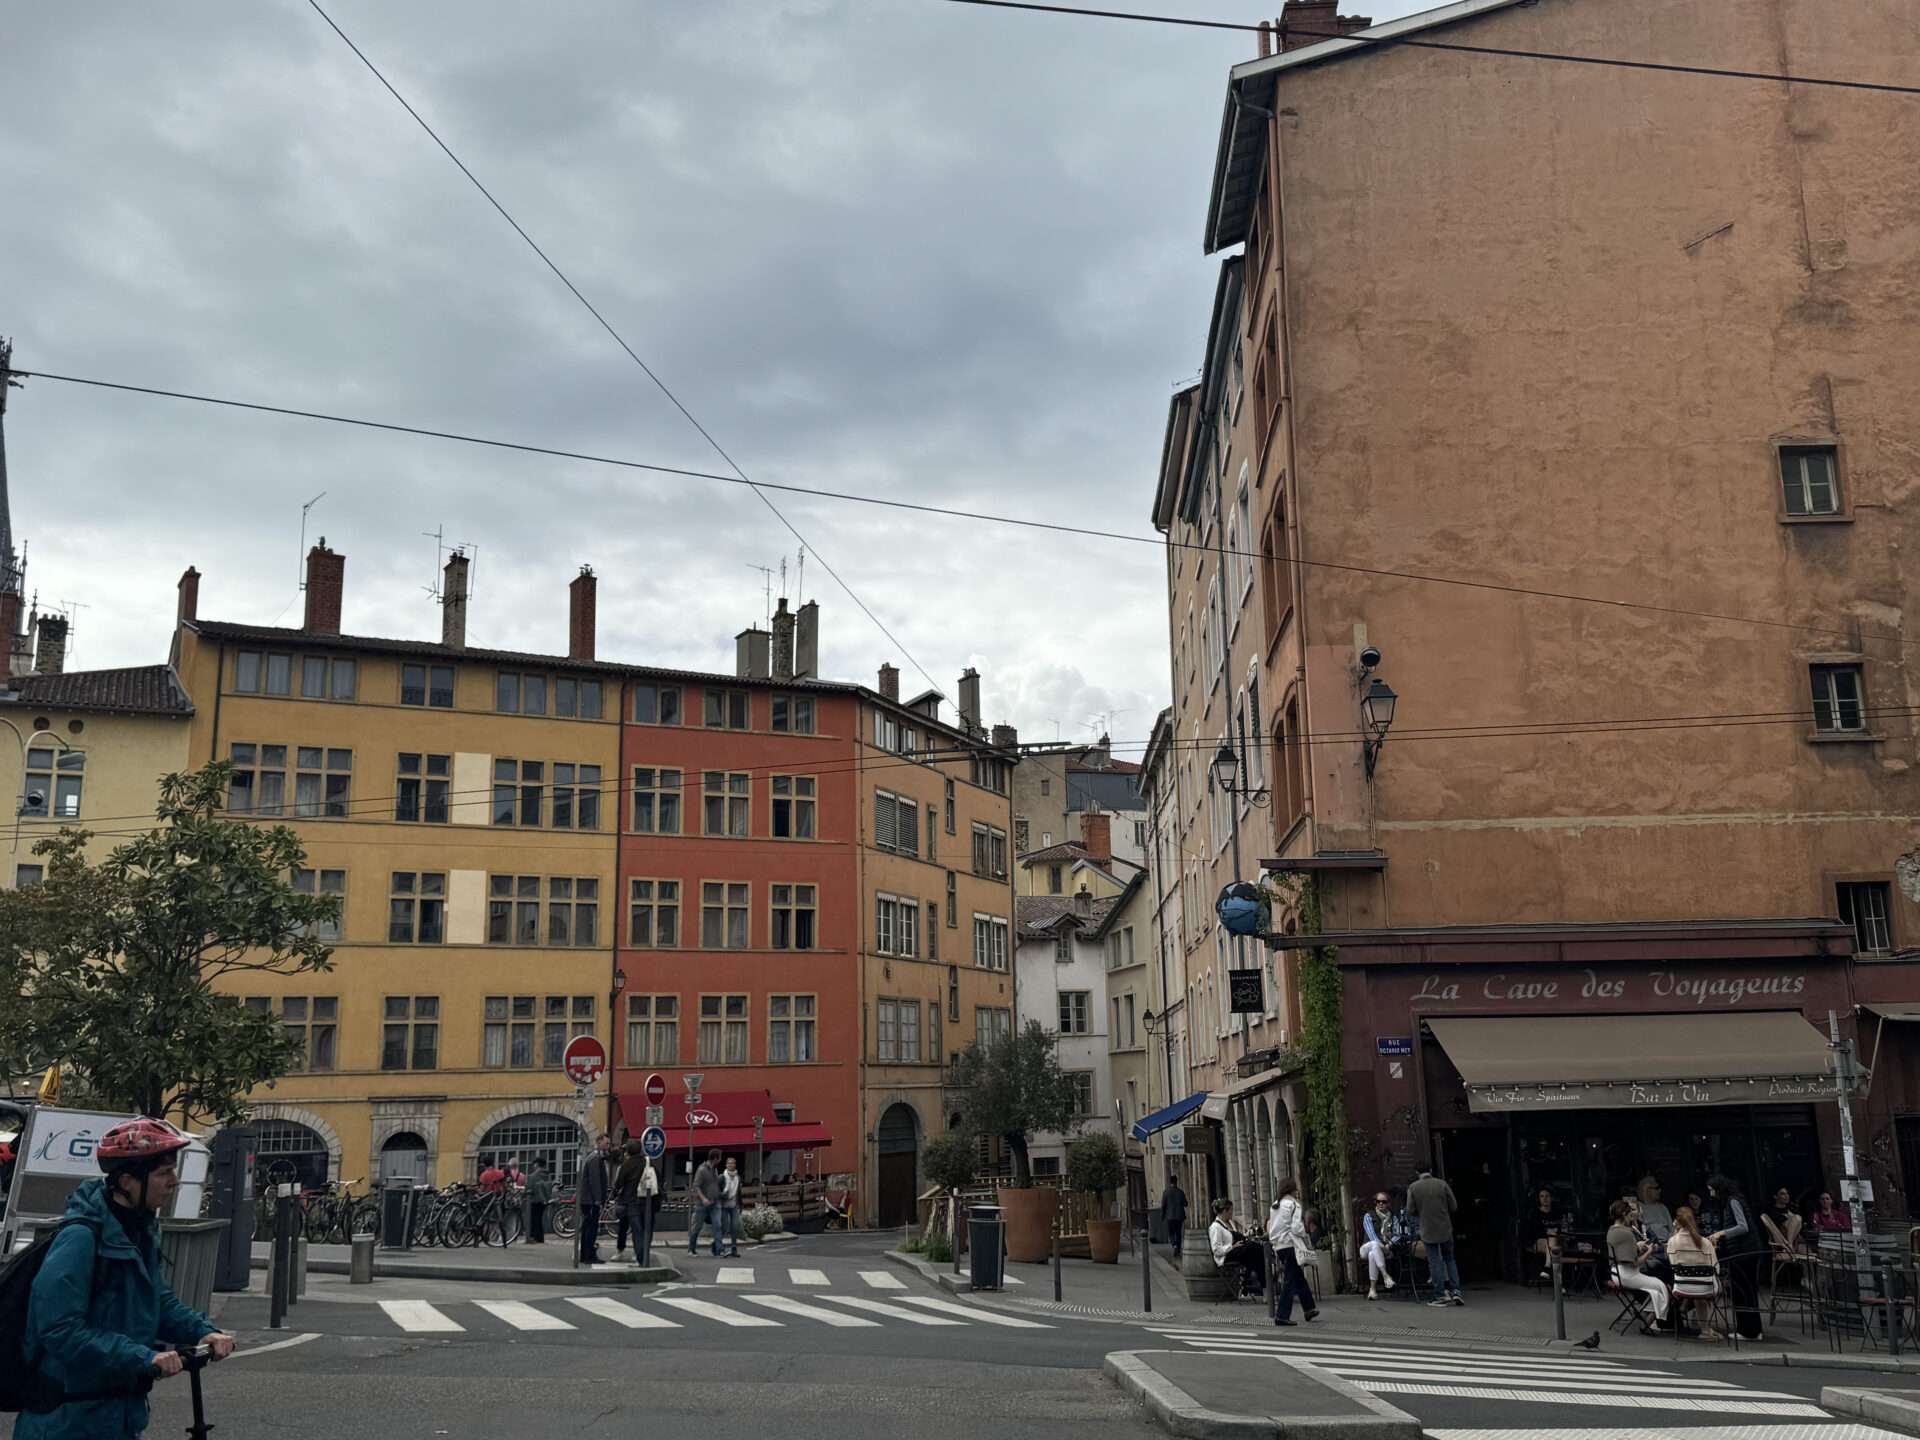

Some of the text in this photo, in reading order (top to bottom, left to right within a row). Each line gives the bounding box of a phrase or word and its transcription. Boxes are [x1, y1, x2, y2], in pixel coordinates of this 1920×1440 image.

[1409, 968, 1805, 1005] La Cave des Voyageurs
[1485, 1092, 1503, 1103] Vin
[1505, 1091, 1525, 1103] Fin
[1629, 1086, 1659, 1103] Bar
[1680, 1083, 1709, 1102] Vin
[1768, 1083, 1804, 1097] Produits
